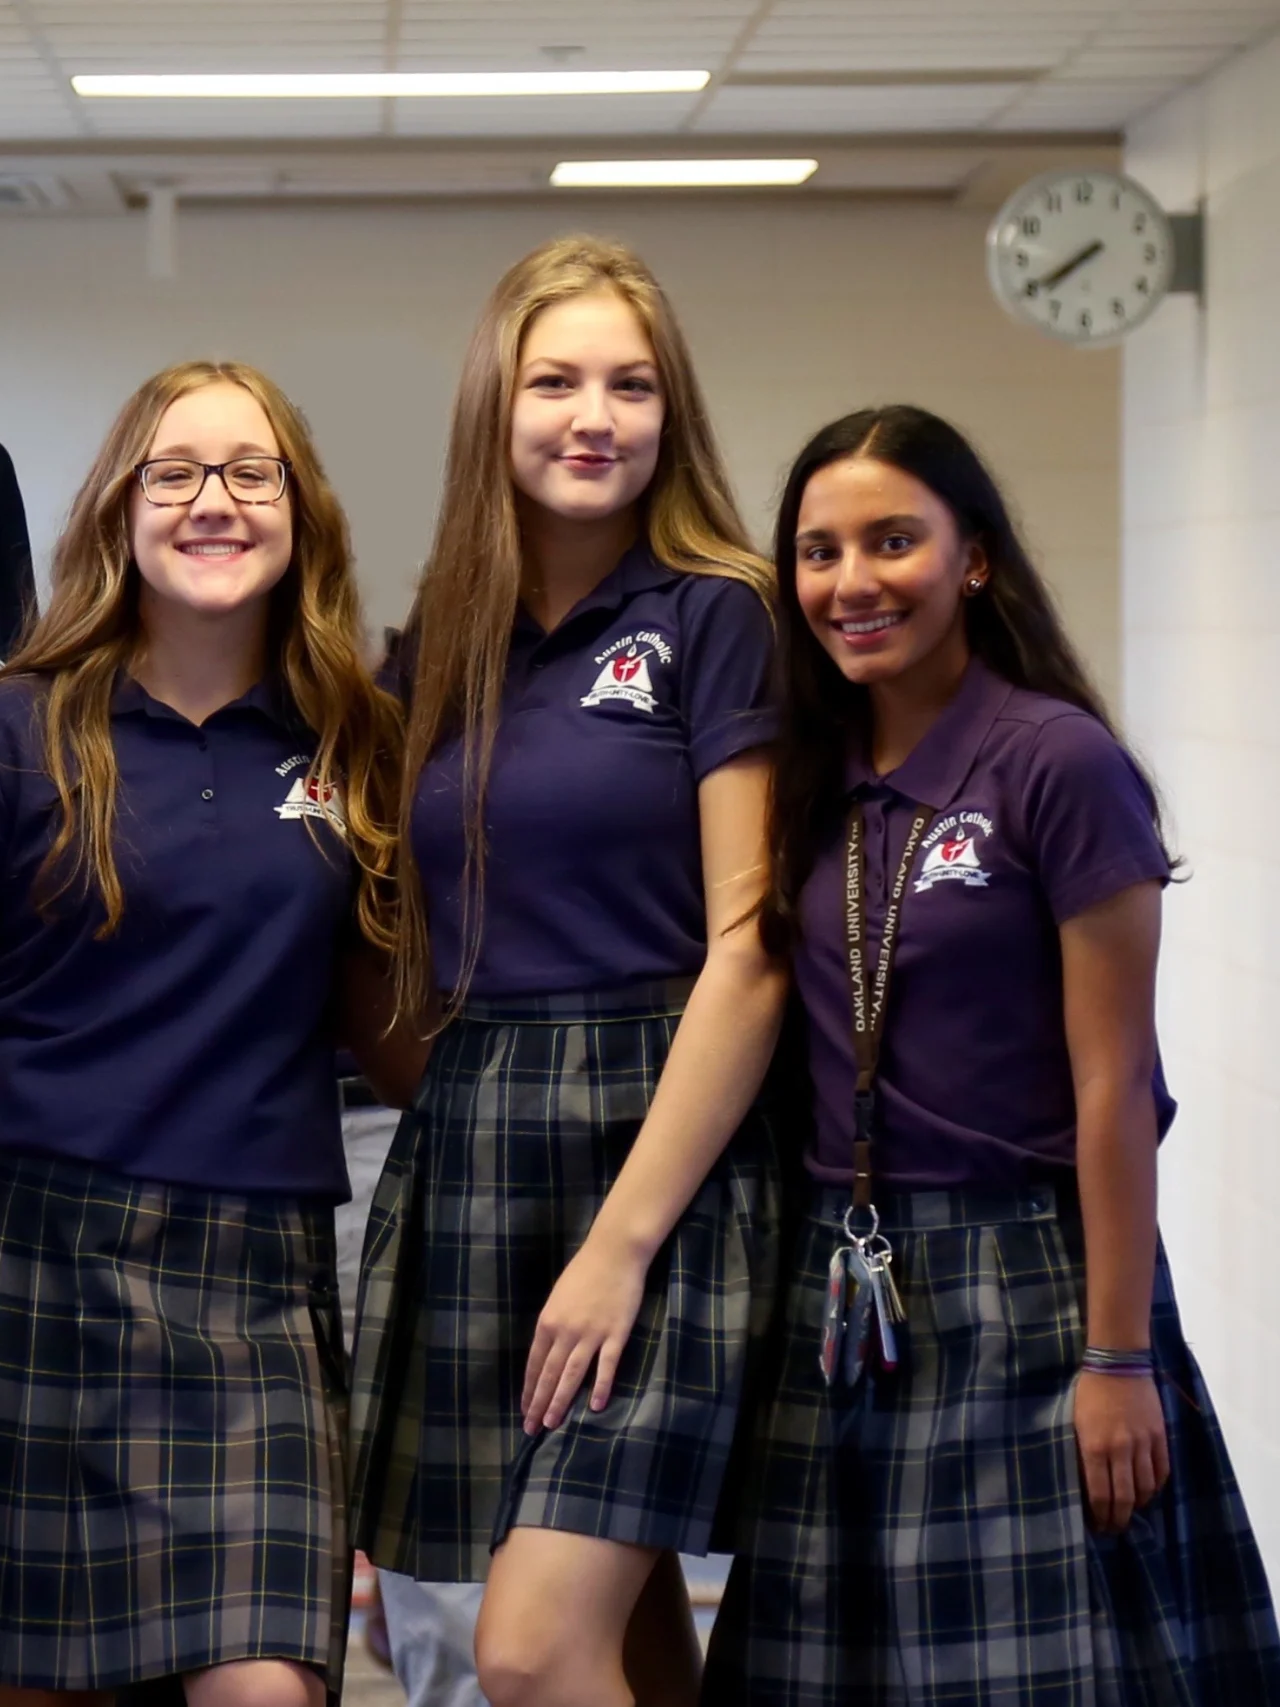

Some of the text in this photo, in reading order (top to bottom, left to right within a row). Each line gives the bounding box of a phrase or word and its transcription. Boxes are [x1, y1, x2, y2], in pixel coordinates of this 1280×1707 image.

[594, 631, 673, 665] Austin Catholic
[275, 755, 310, 777] Austin
[921, 816, 957, 849] Austin
[893, 817, 925, 898] OAKLAND
[849, 948, 865, 1032] OAKLAND
